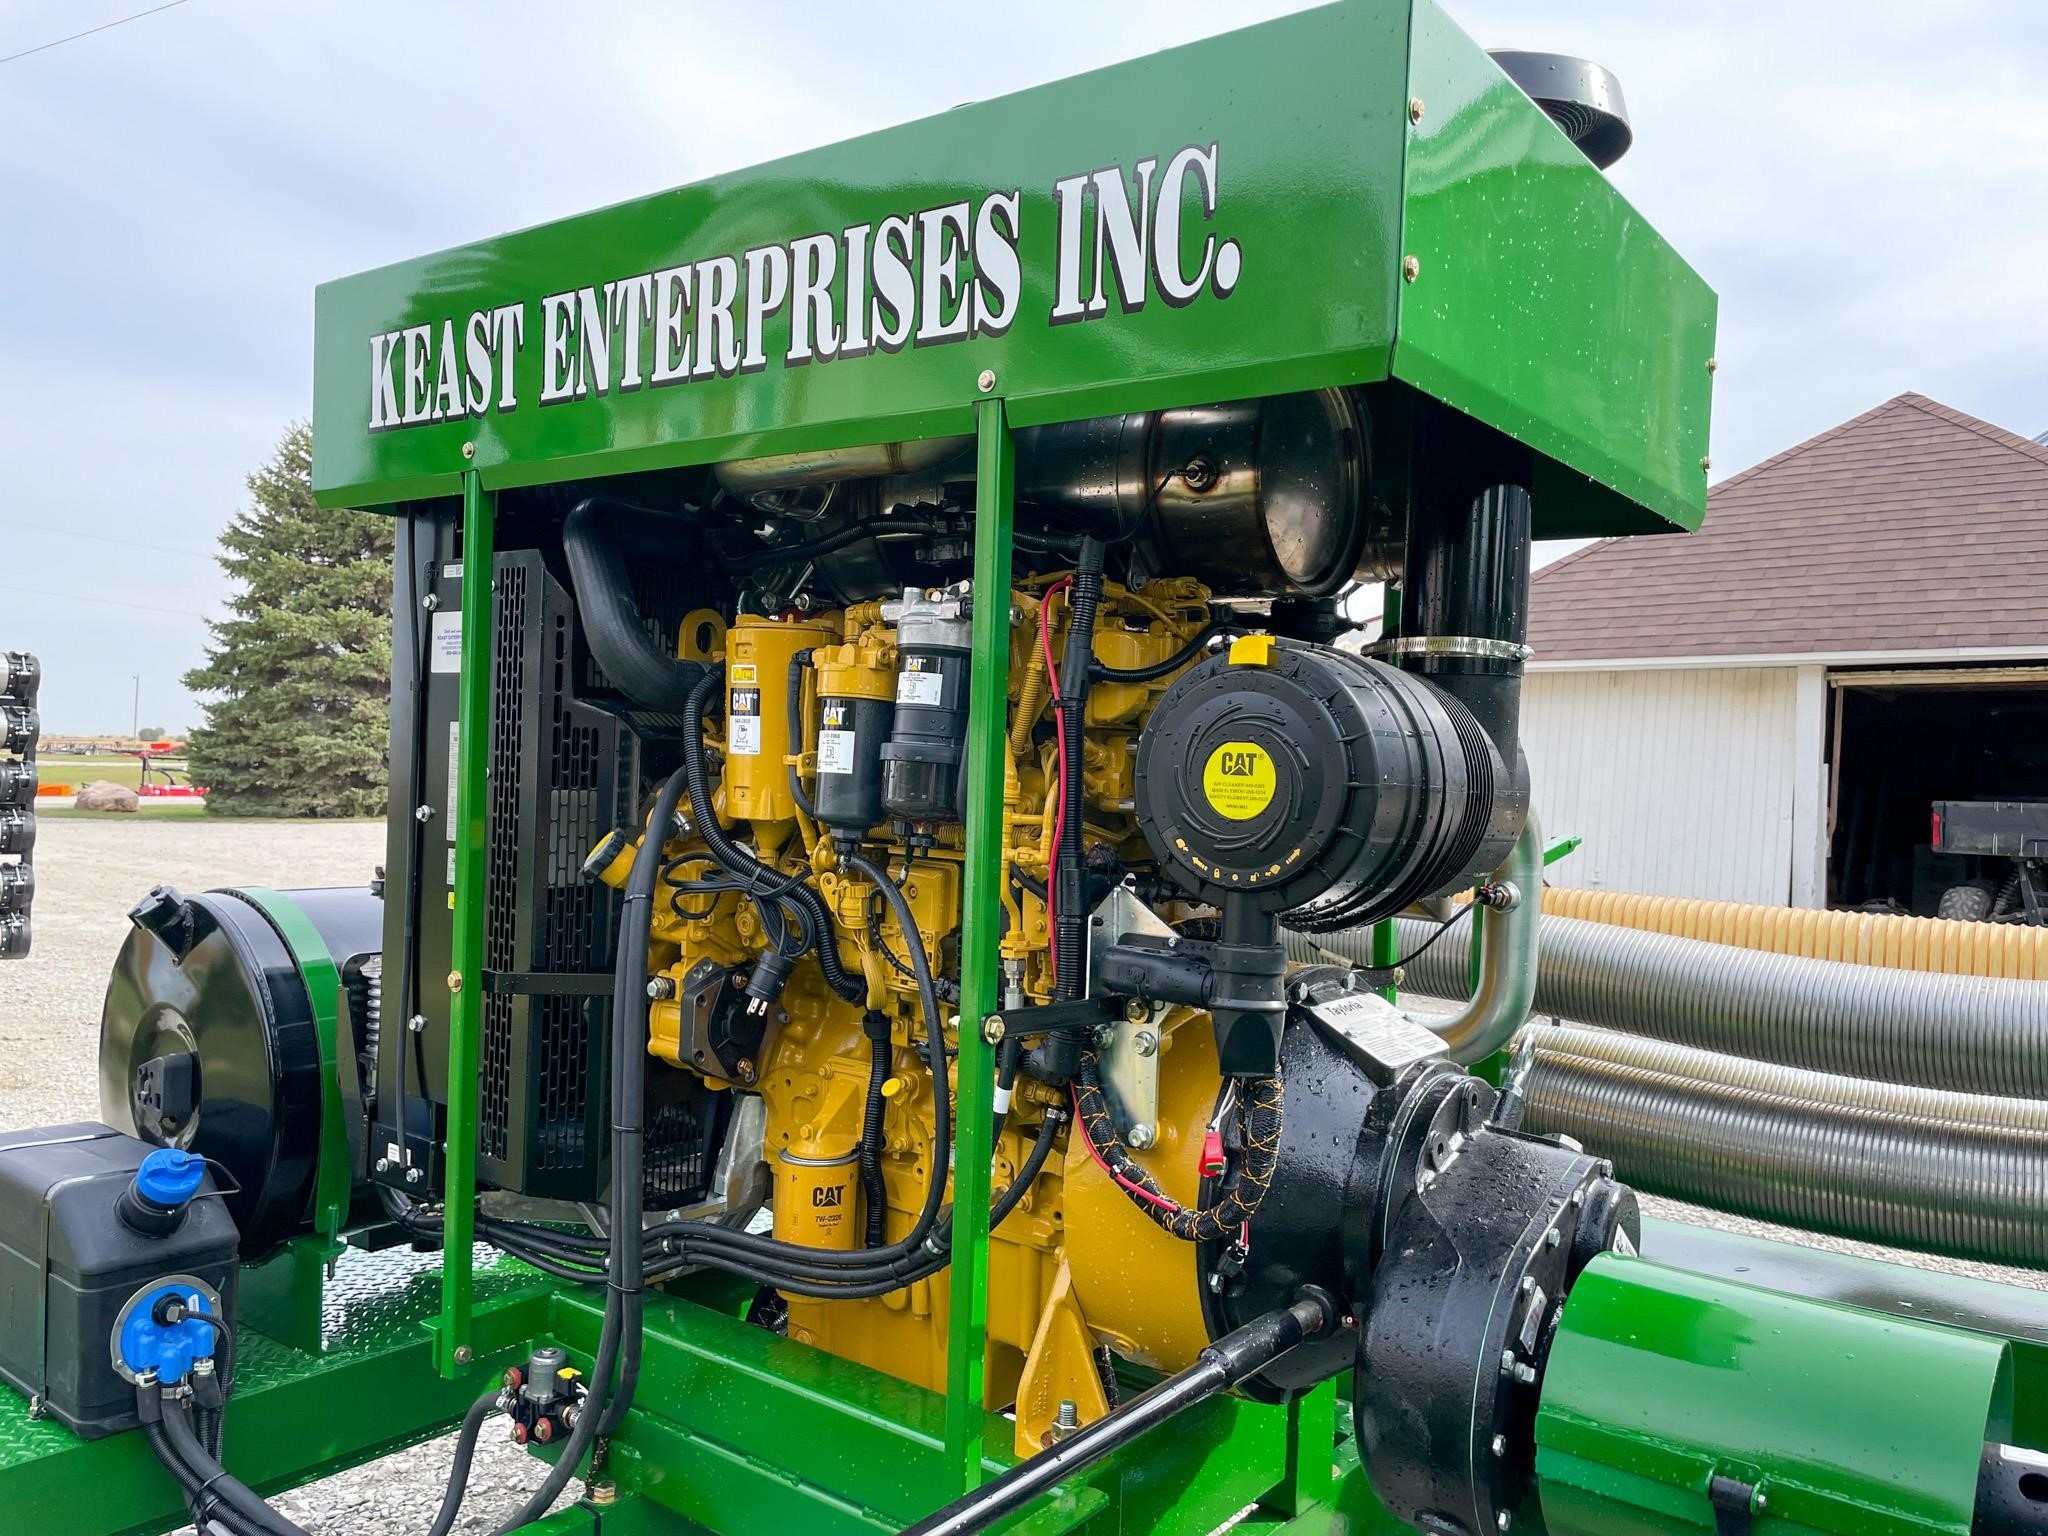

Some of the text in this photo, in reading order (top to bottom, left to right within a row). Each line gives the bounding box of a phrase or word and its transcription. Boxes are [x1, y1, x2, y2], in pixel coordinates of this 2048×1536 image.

[368, 139, 1243, 434] KEAST ENTERPRISES INC.
[906, 658, 923, 671] CAT
[732, 693, 753, 710] CAT
[823, 707, 846, 726] CAT
[1222, 752, 1258, 776] CAT
[813, 1185, 844, 1207] CAT
